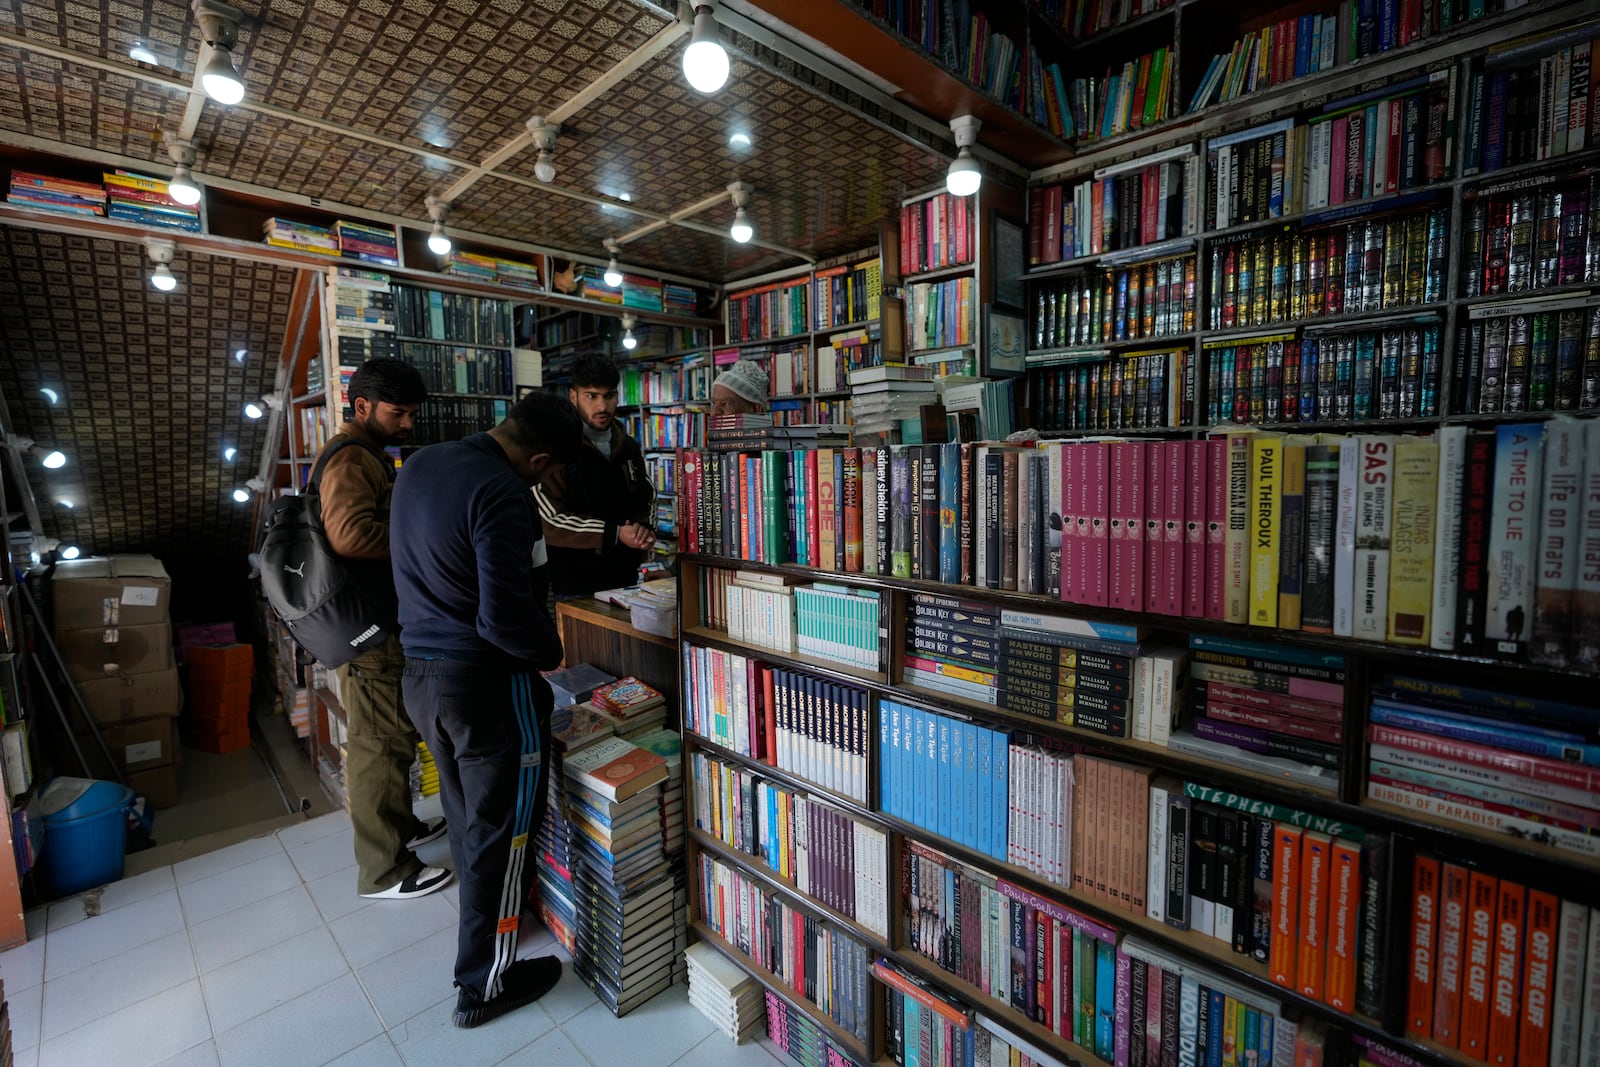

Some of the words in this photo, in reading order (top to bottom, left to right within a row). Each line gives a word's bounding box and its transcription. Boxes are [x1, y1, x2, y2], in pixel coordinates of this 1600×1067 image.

[1350, 119, 1361, 140] DAN
[1349, 141, 1361, 171] BROWN
[1478, 183, 1512, 196] SERIAL
[1514, 175, 1555, 188] KILLERS
[1185, 350, 1193, 362] THE
[1185, 363, 1193, 380] WILD
[1185, 384, 1193, 401] EAST
[1515, 434, 1527, 445] A
[877, 449, 889, 482] sidney
[961, 458, 970, 480] Holy
[1213, 443, 1222, 483] Immigrant,
[1260, 448, 1274, 481] PAUL
[1365, 443, 1387, 485] SAS
[1510, 448, 1528, 486] TIME
[843, 458, 857, 508] SHADOW
[960, 480, 970, 500] War,
[1231, 461, 1247, 509] RUSSIAN
[1364, 492, 1374, 501] IN
[1453, 463, 1465, 519] STEPHEN
[1550, 473, 1576, 500] life
[820, 481, 834, 531] CHE
[877, 483, 888, 522] sheldon
[961, 502, 969, 518] Inc.
[1213, 486, 1221, 516] Montana
[1363, 502, 1374, 527] ARMS
[1374, 487, 1385, 532] BROTHERS
[1508, 490, 1526, 513] TO
[705, 502, 713, 532] POTTER
[1231, 509, 1246, 530] JOB
[1258, 485, 1273, 548] THEROUX
[1395, 499, 1413, 553] VILLAGES
[1506, 517, 1523, 541] LIE
[1551, 509, 1568, 528] on
[979, 553, 985, 566] ME
[1050, 550, 1062, 575] Brida
[1233, 541, 1241, 570] DOUGLAS
[1450, 524, 1463, 583] HAWKING
[1545, 536, 1566, 579] mars
[1366, 554, 1377, 588] Damien
[1499, 550, 1514, 601] BERTHON
[1514, 564, 1525, 588] Simon
[915, 604, 936, 617] GOLDEN
[937, 608, 950, 620] KEY
[1365, 589, 1375, 614] Lewis
[914, 637, 935, 650] GOLDEN
[936, 641, 949, 653] KEY
[1008, 640, 1053, 653] MASTERS
[1023, 649, 1052, 660] WORD
[1080, 654, 1104, 664] WILLIAM
[1080, 660, 1111, 670] BERNSTEIN
[1211, 688, 1221, 696] The
[1222, 688, 1245, 700] Pilgrim's
[1245, 694, 1270, 705] Progress
[573, 740, 625, 766] Bryson
[584, 742, 605, 754] Bill
[1380, 731, 1433, 752] STRAIGHT
[1436, 740, 1465, 758] TALK
[1467, 748, 1483, 762] ON
[1389, 752, 1406, 761] The
[1406, 755, 1446, 770] WISDOM
[1447, 764, 1457, 772] of
[1459, 766, 1501, 782] MORRIE
[1185, 781, 1273, 819] STEPHEN
[1290, 809, 1342, 834] KING
[1374, 787, 1411, 805] BIRDS
[1416, 797, 1431, 810] OF
[1436, 803, 1504, 828] PARADISE
[1282, 846, 1292, 875] Where's
[1280, 875, 1289, 885] my
[1278, 885, 1290, 906] happy
[1418, 894, 1433, 921] OFF
[1278, 907, 1289, 935] ending?
[1447, 901, 1462, 929] OFF
[1417, 923, 1431, 946] THE
[1445, 930, 1460, 955] THE
[1133, 962, 1144, 994] PREETI
[1415, 948, 1430, 983] CLIFF
[1443, 956, 1458, 992] CLIFF
[1165, 975, 1175, 1009] PREETI
[1200, 990, 1208, 1018] KAMALA
[1132, 997, 1143, 1038] SHENOY
[1163, 1011, 1174, 1051] SHENOY
[1199, 1020, 1207, 1047] HARRIS
